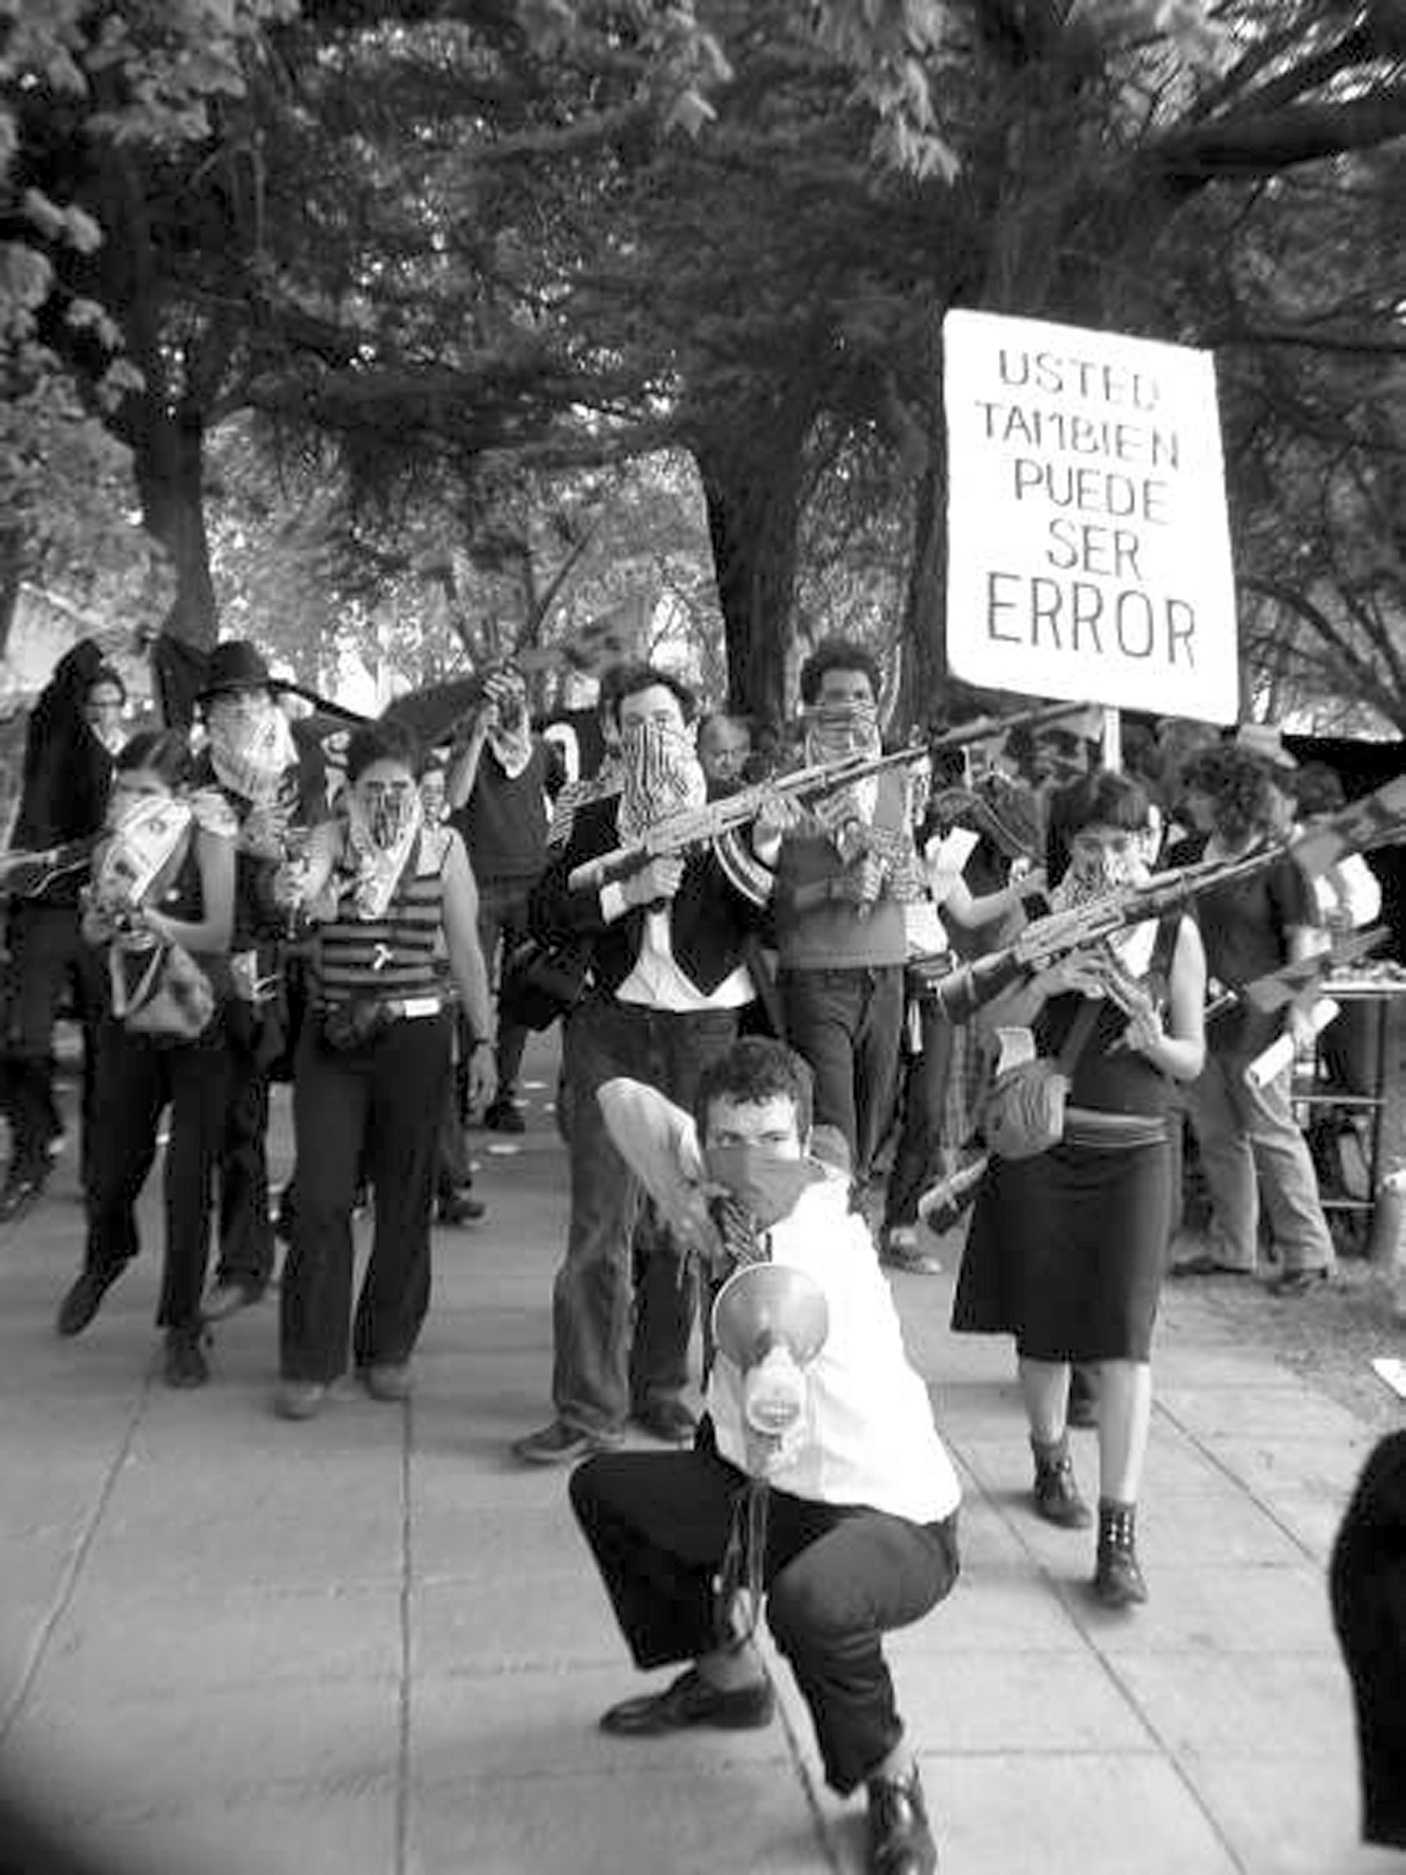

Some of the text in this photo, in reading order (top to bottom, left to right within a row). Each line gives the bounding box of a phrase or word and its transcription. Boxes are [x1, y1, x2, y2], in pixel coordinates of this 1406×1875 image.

[1000, 349, 1159, 411] USTED
[975, 400, 1179, 470] TAMBIEN
[1015, 458, 1168, 525] PUEDE
[1047, 518, 1142, 581] SER
[987, 571, 1196, 668] ERROR
